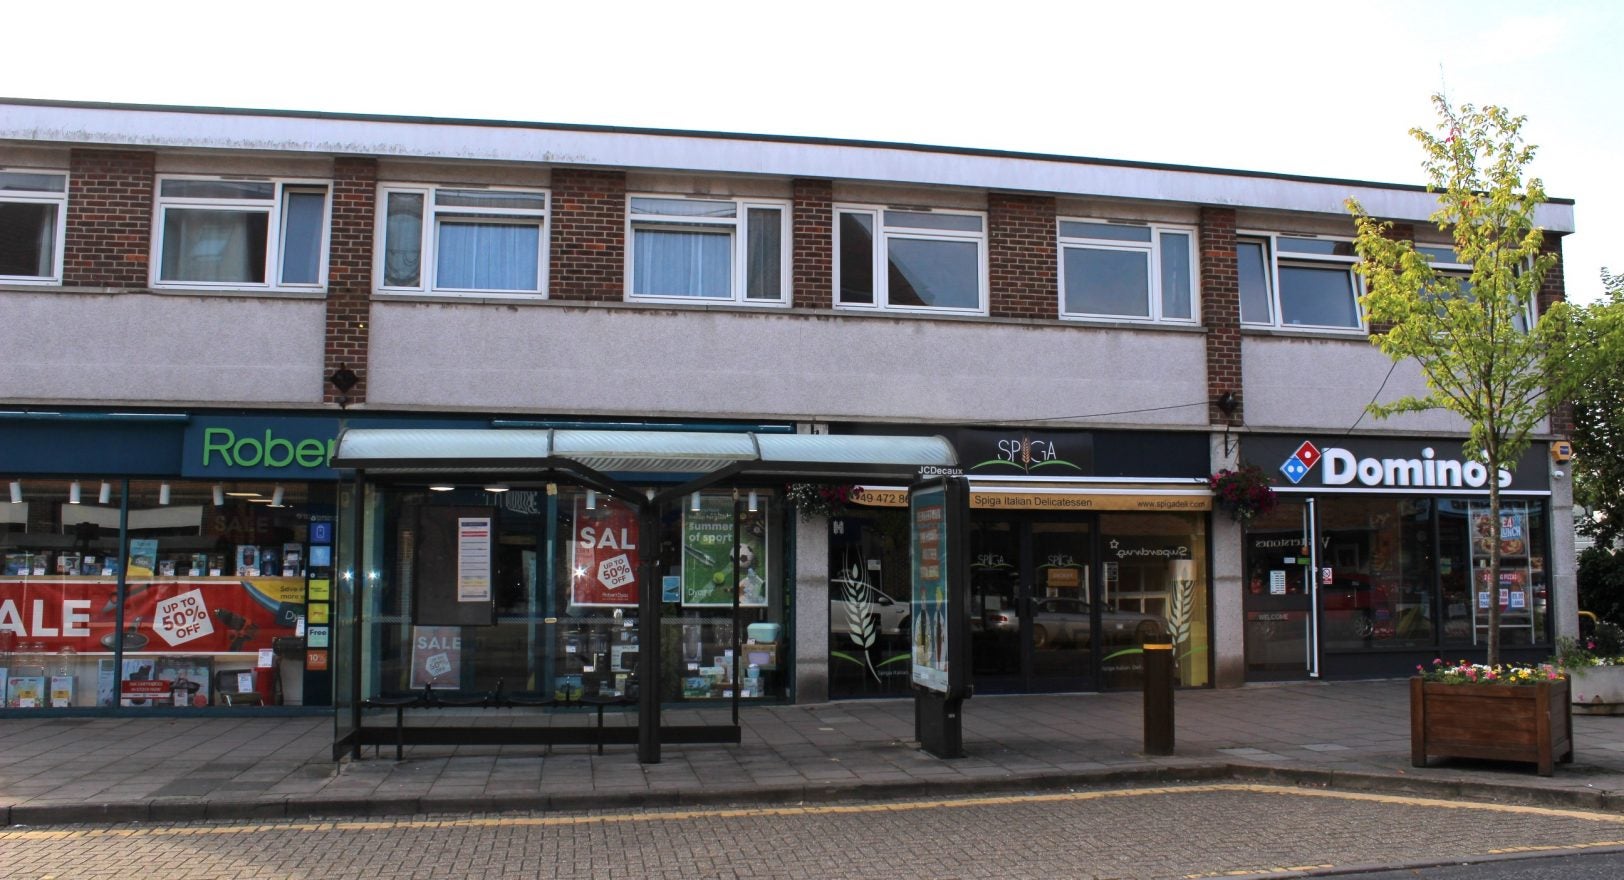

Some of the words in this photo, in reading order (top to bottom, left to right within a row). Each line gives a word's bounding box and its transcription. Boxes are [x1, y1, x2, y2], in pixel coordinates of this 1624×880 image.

[997, 434, 1057, 464] SPIGA
[918, 465, 963, 475] JCDecaux
[876, 494, 896, 504] 472
[974, 495, 1001, 507] Spiga
[1004, 495, 1032, 506] Italian
[1034, 496, 1093, 508] Delicatessen
[1136, 500, 1206, 510] www.spigadeli.com
[688, 532, 701, 542] of
[703, 533, 733, 545] sport
[603, 564, 630, 580] 50%
[611, 575, 626, 584] OFF
[162, 603, 178, 614] UP
[180, 597, 196, 608] TO
[0, 599, 91, 637] ALE
[162, 605, 206, 631] 50%
[176, 623, 201, 638] OFF
[417, 636, 461, 650] SALE
